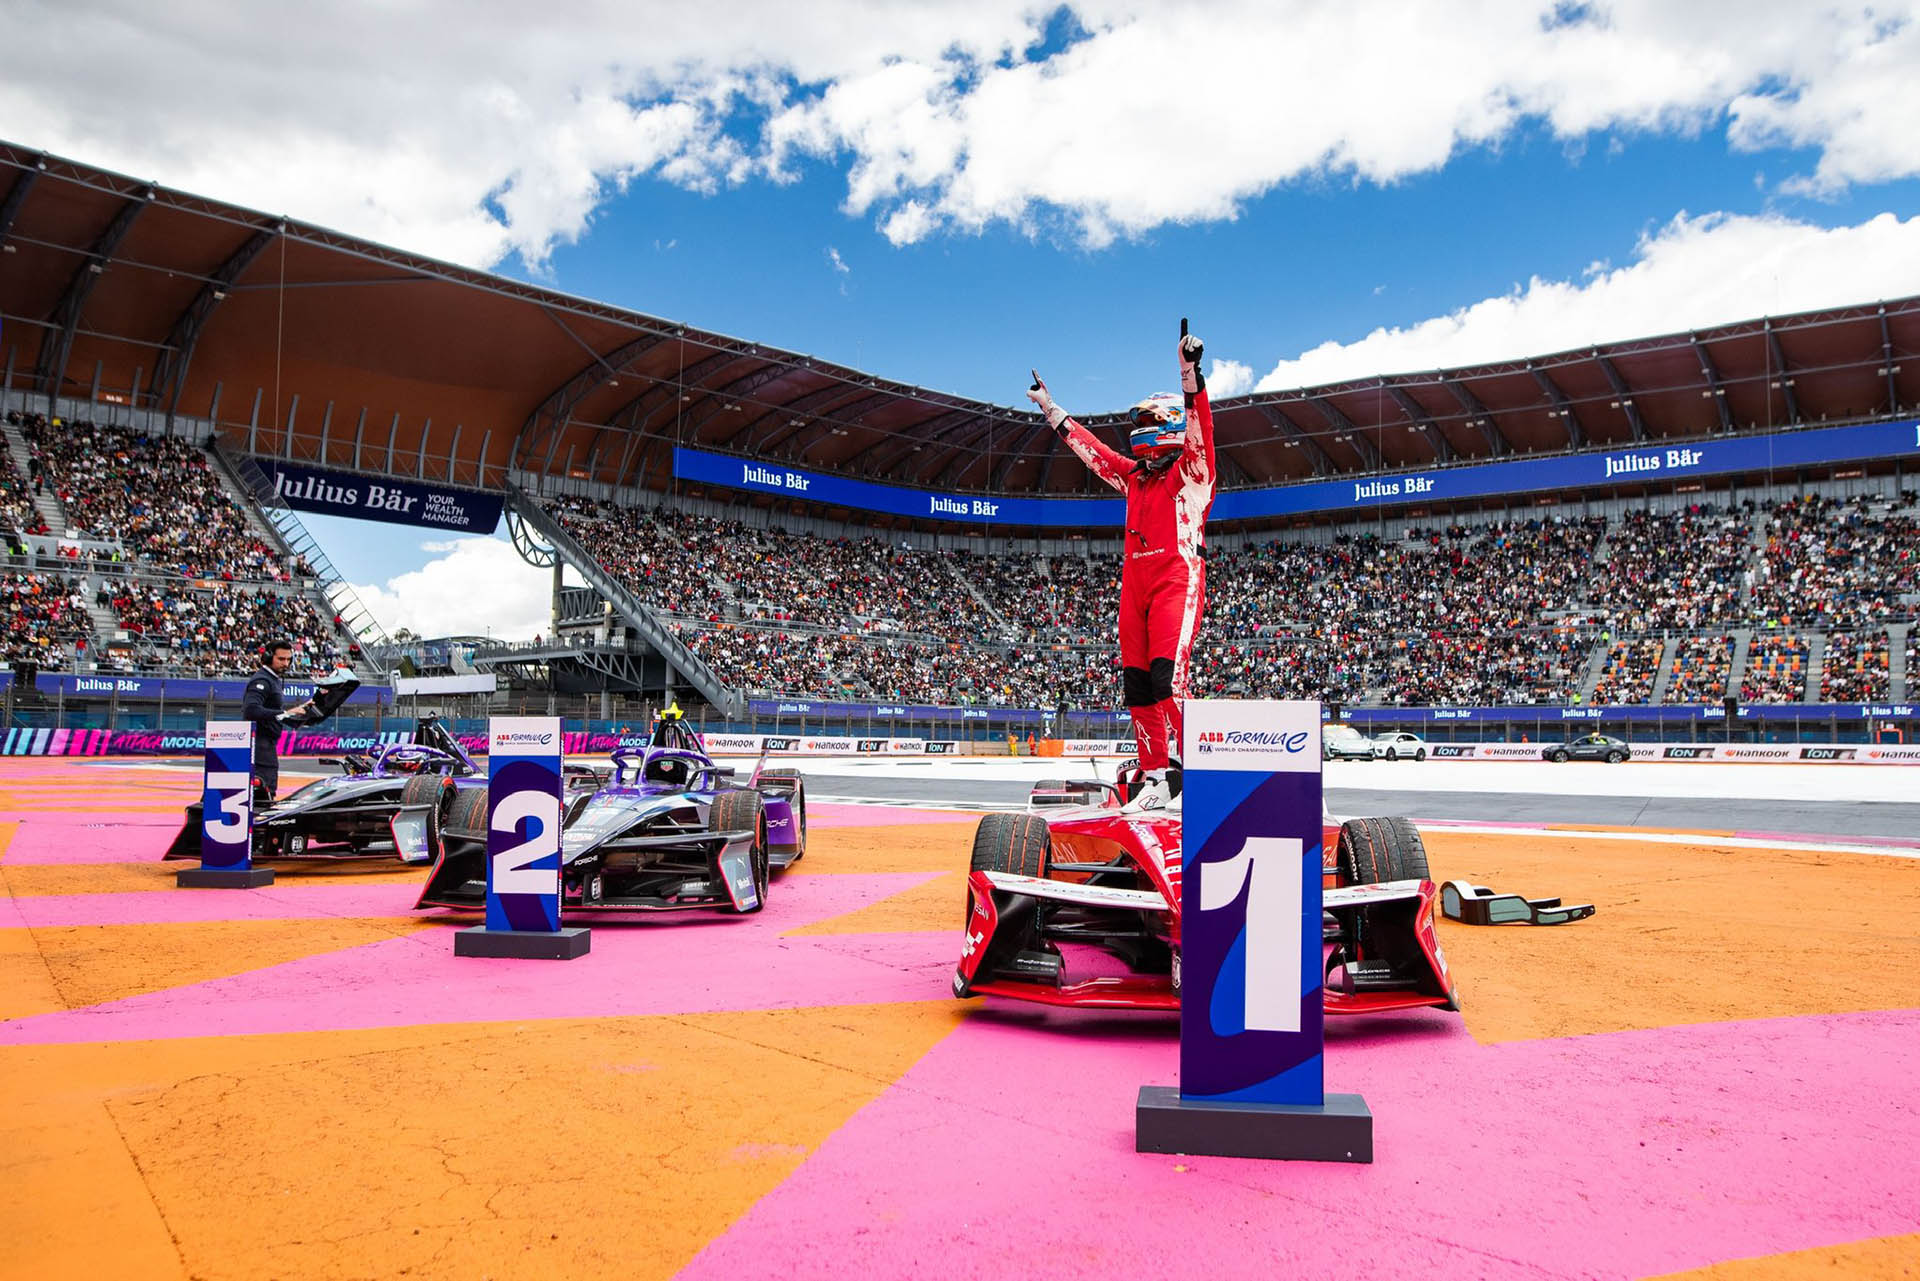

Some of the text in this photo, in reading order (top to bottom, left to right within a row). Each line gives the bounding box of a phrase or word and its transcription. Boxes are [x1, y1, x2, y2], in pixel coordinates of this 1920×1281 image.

[1605, 449, 1703, 478] Julius Bär
[743, 464, 810, 491] Julius Bär
[272, 471, 418, 513] Julius Bär
[1354, 476, 1435, 501] Julius Bär
[428, 493, 455, 505] YOUR
[424, 503, 465, 516] WEALTH
[930, 496, 999, 516] Julius Bär
[421, 511, 470, 526] MANAGER
[76, 678, 141, 691] Julius Bär
[283, 687, 311, 697] ulius
[1562, 709, 1603, 718] Julius Bär
[1704, 707, 1725, 717] Juliu
[161, 737, 206, 748] MODE
[337, 738, 376, 749] MODE
[619, 738, 648, 746] MODE
[1199, 732, 1224, 743] ABB
[1225, 731, 1288, 745] FORMULA
[1199, 744, 1212, 753] FIA
[205, 771, 250, 845] 3
[491, 790, 560, 895] 2
[1200, 837, 1303, 1032] 1
